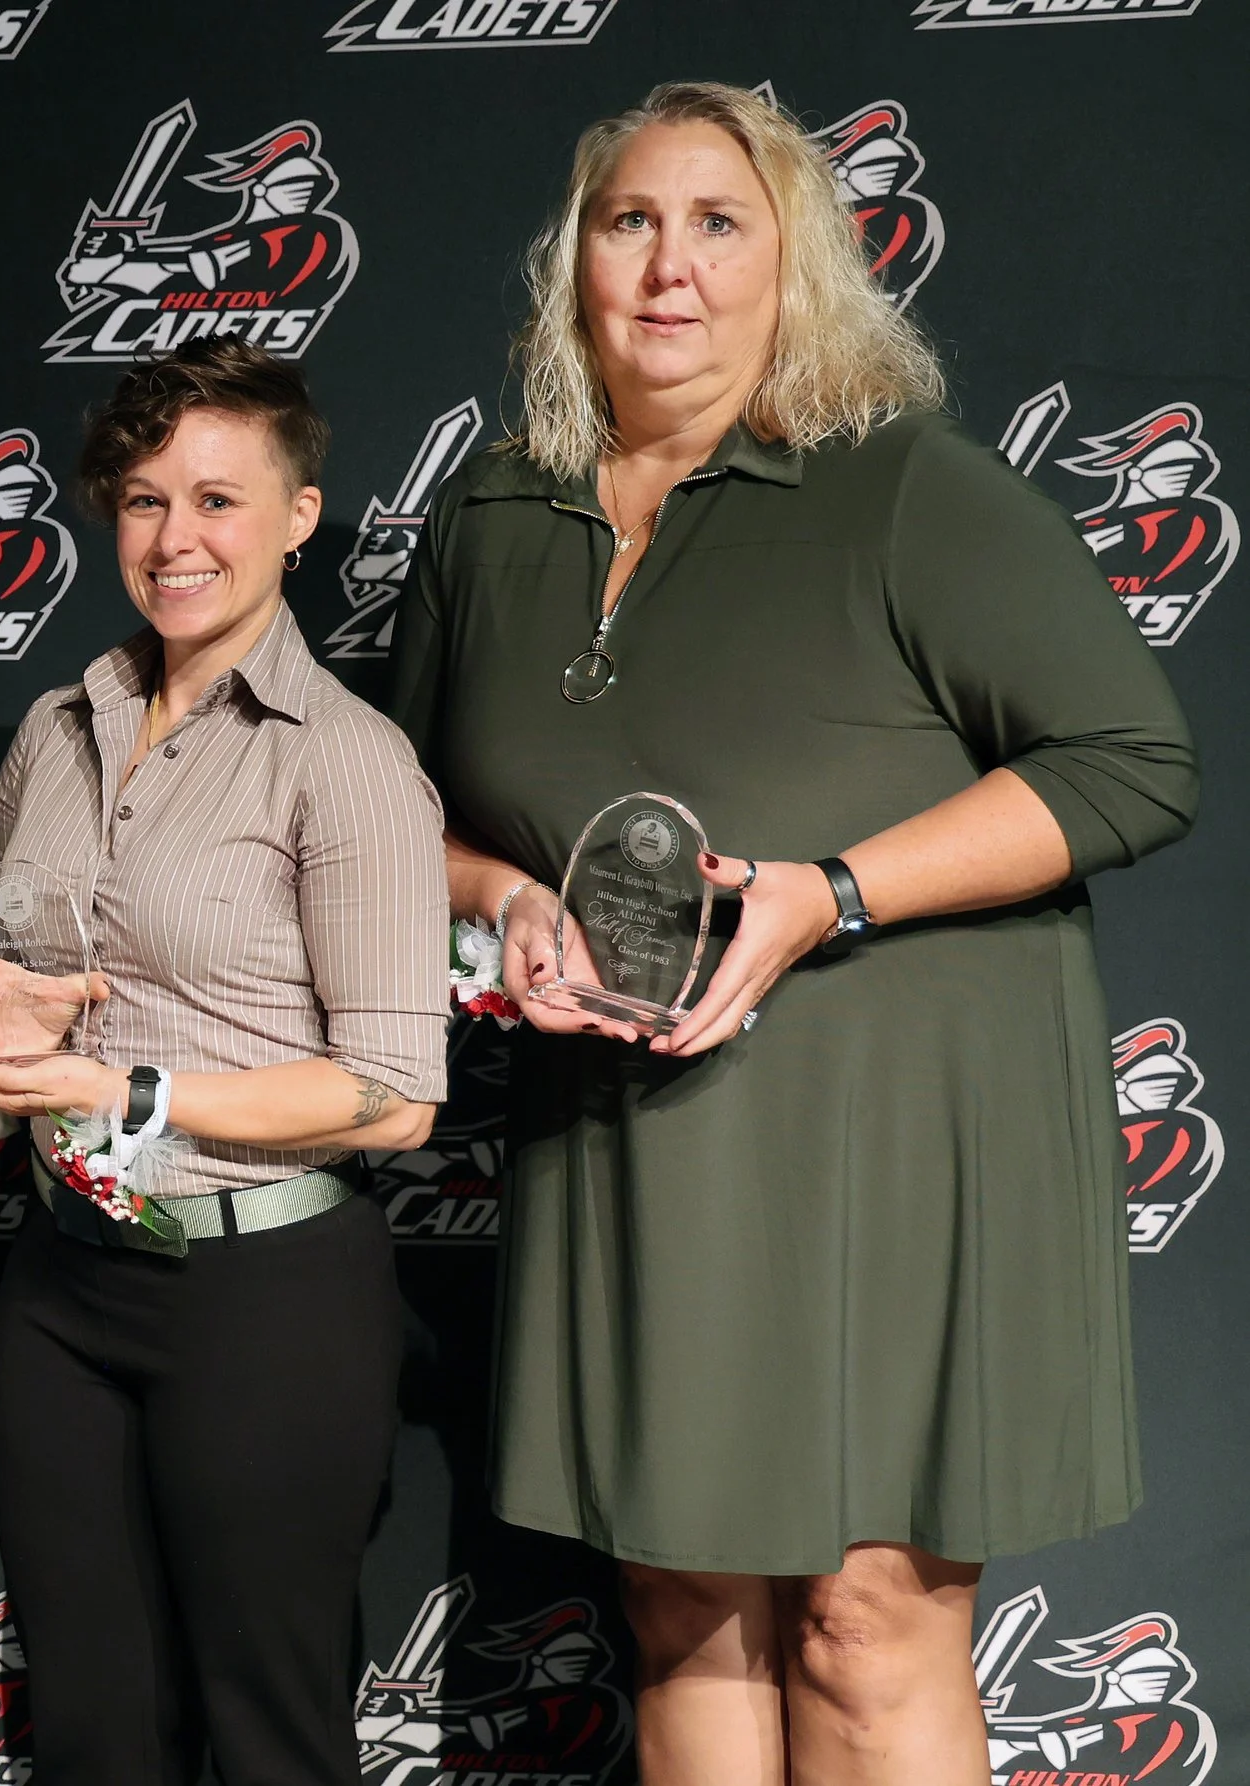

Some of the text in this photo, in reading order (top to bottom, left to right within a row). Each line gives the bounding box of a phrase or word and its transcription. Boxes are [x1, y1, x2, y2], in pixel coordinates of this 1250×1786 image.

[161, 291, 286, 309] HILTON
[589, 864, 617, 881] Maureen
[595, 889, 678, 919] Hilton High School
[617, 909, 657, 927] ALUMNI
[617, 944, 670, 966] Class of 1983
[1009, 1770, 1130, 1786] HILTON
